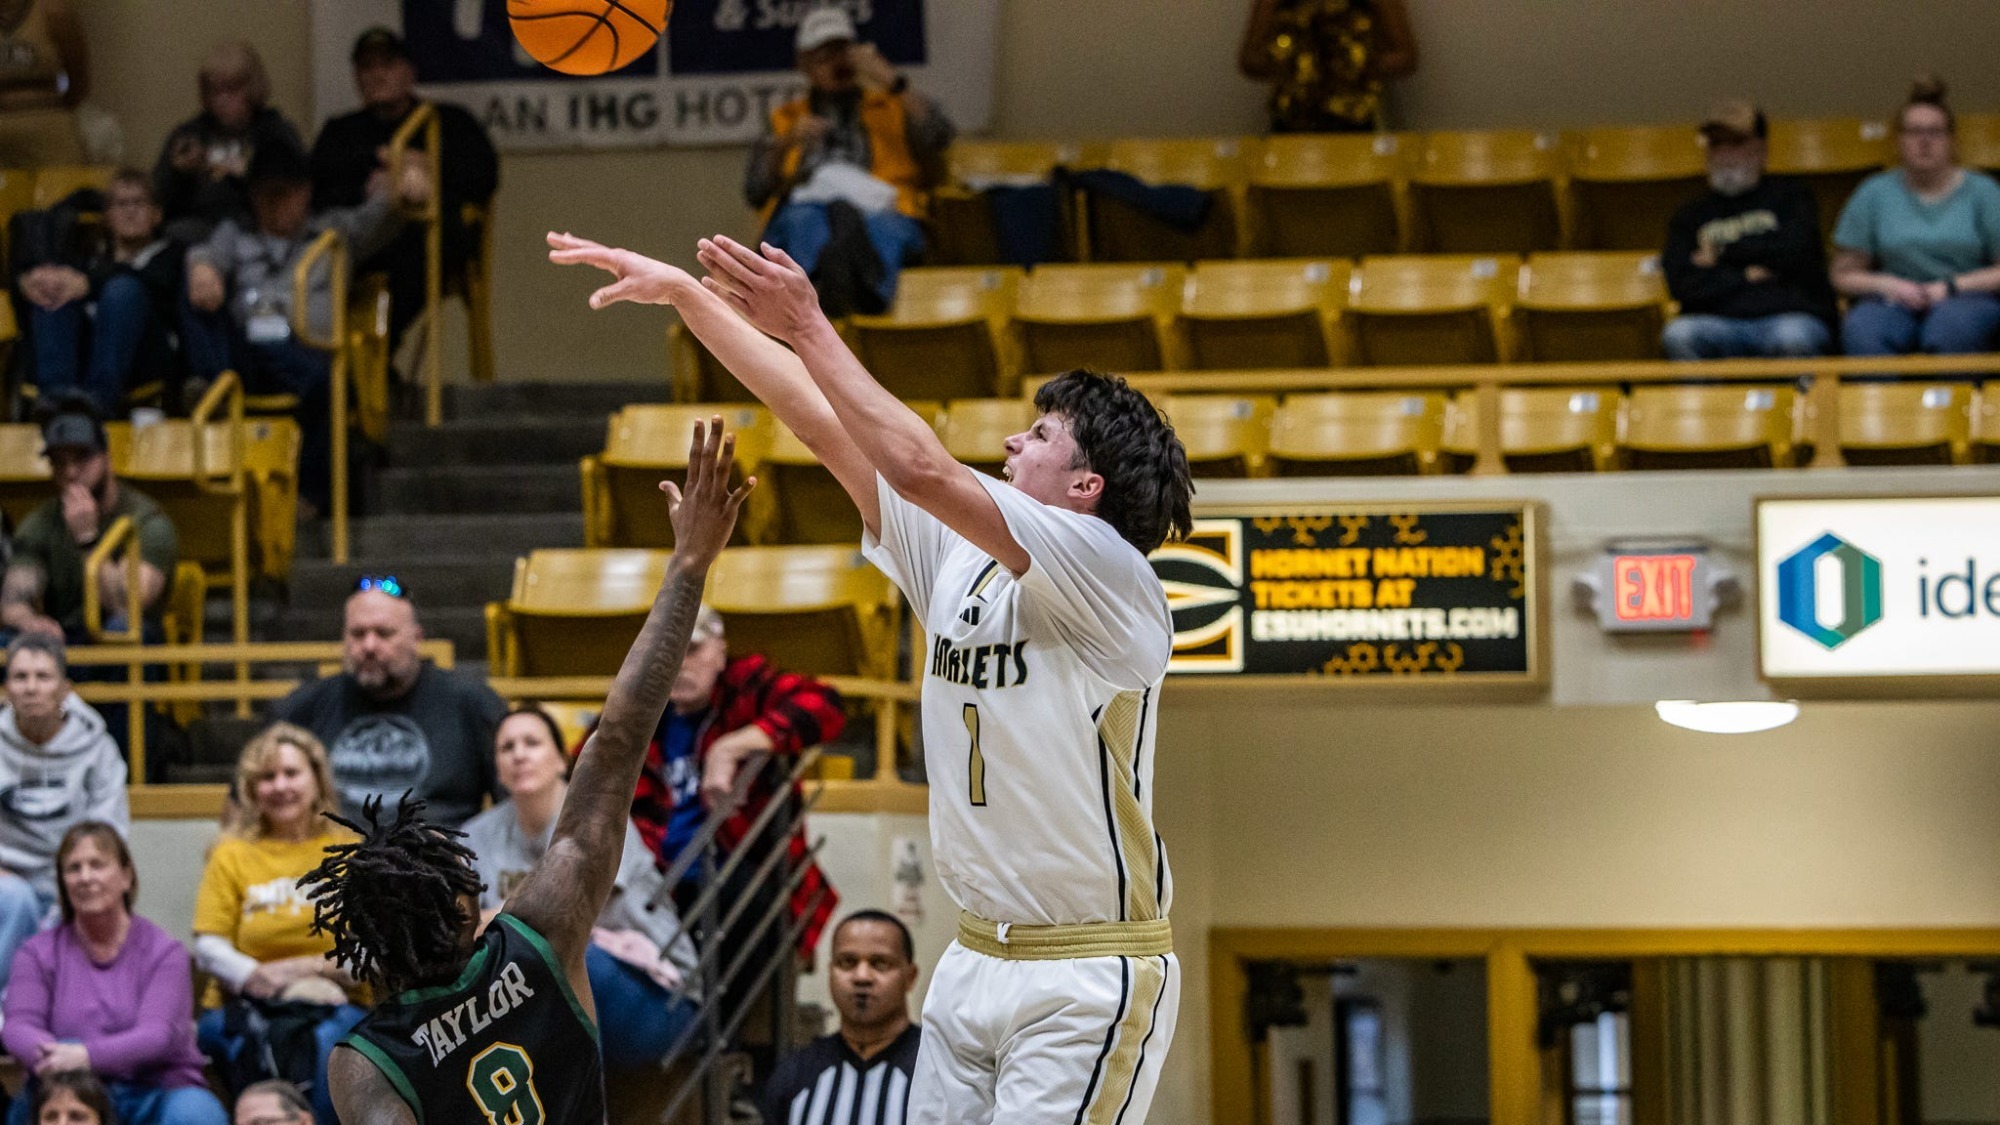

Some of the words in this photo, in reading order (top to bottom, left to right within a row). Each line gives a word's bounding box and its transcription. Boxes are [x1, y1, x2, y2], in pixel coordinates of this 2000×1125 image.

[485, 95, 546, 130] AN
[568, 91, 660, 130] IHG
[1251, 548, 1371, 579] HORNET
[1373, 547, 1485, 577] NATION
[1614, 555, 1696, 621] EXIT
[1250, 579, 1373, 609] TICKETS
[1375, 578, 1416, 608] AT
[1251, 607, 1519, 641] ESUHORNETS.COM
[963, 703, 987, 807] 1
[411, 962, 534, 1068] TAYLOR
[466, 1041, 546, 1125] 8
